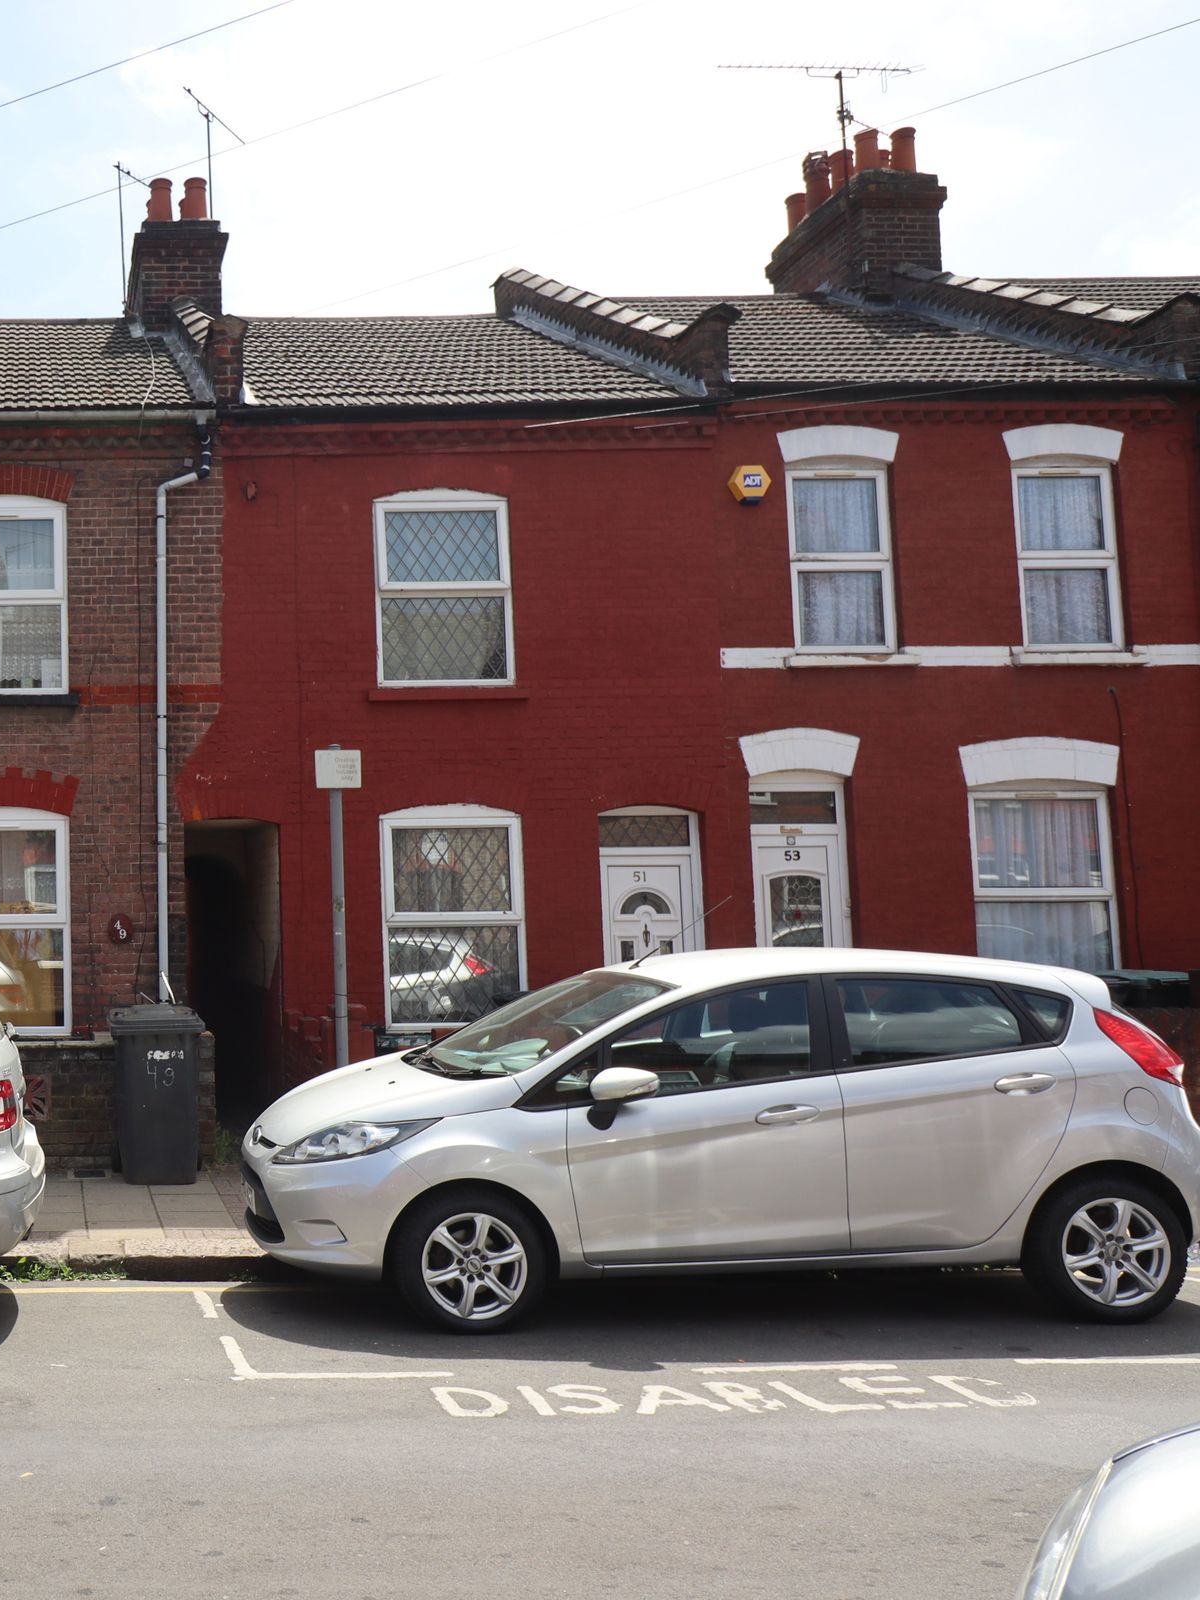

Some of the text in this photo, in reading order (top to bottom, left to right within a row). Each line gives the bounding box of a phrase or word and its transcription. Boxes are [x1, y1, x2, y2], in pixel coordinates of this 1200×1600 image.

[744, 475, 761, 486] ADT
[784, 850, 801, 861] 53
[632, 871, 646, 882] 51
[146, 1061, 175, 1088] 49
